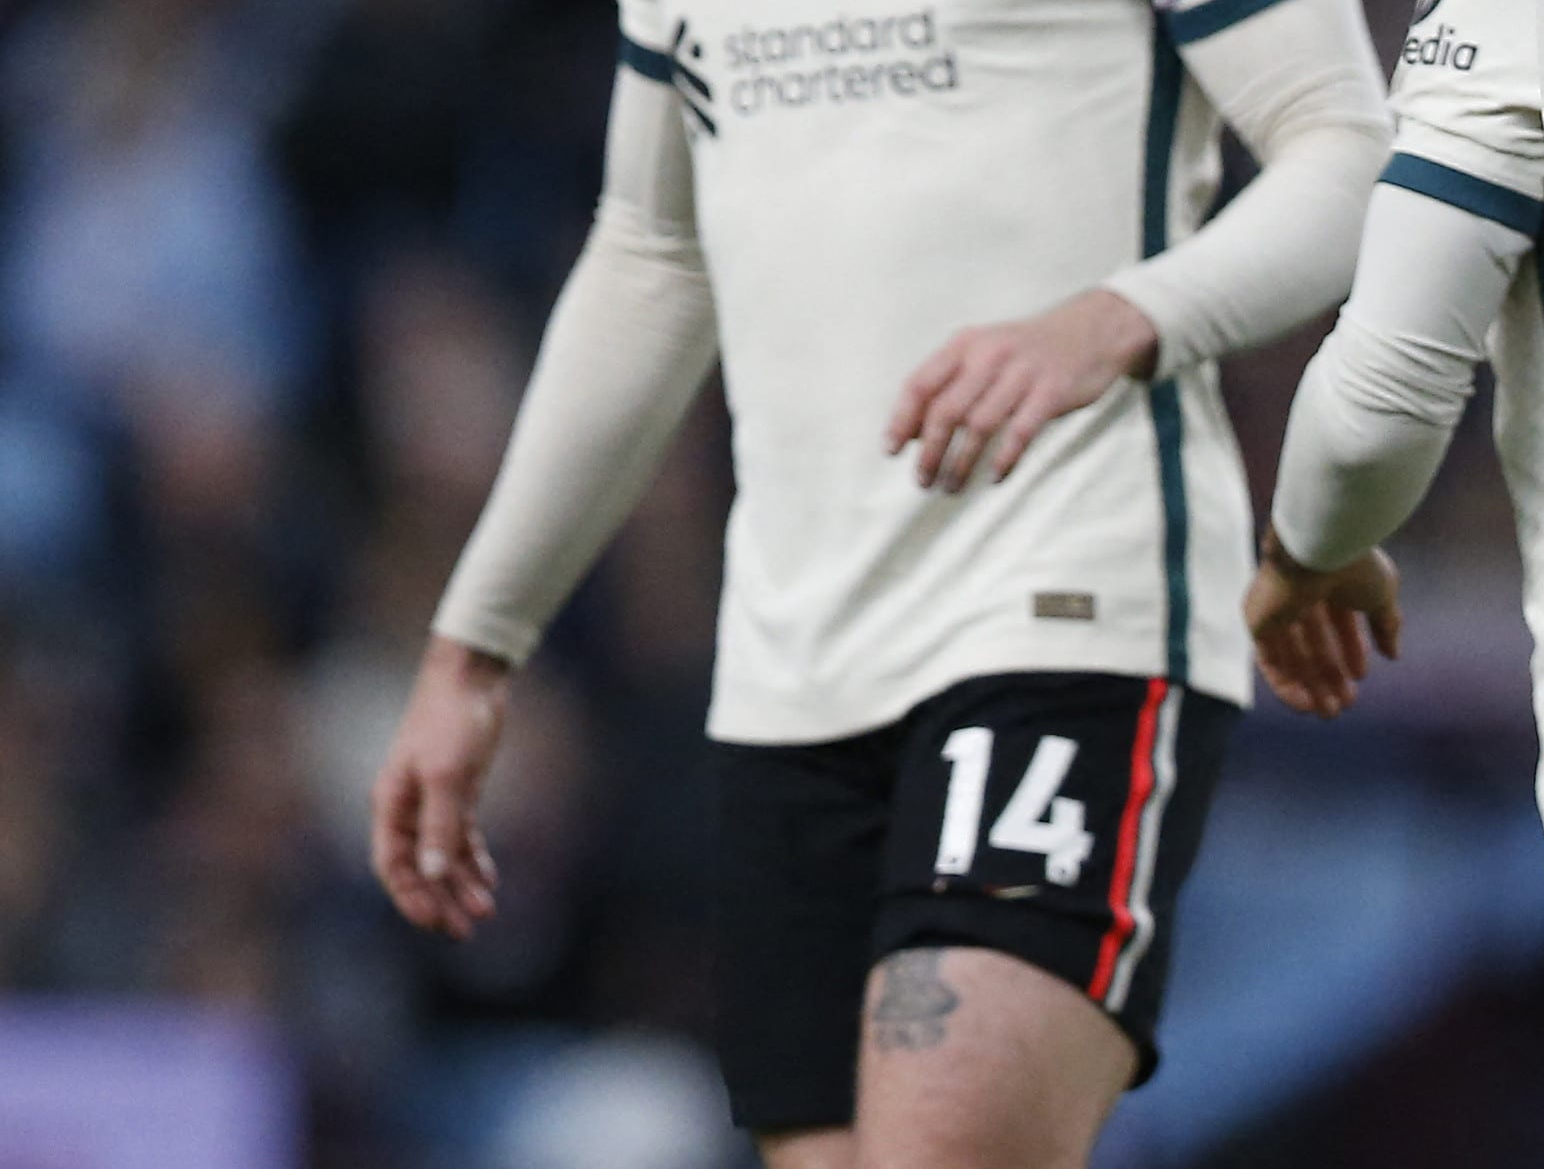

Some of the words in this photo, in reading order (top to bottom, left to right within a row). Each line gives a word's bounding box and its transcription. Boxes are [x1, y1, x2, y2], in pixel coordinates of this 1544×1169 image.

[724, 8, 934, 67] standard
[1402, 23, 1478, 71] edia
[731, 51, 960, 114] chartered
[935, 726, 1095, 886] 14
